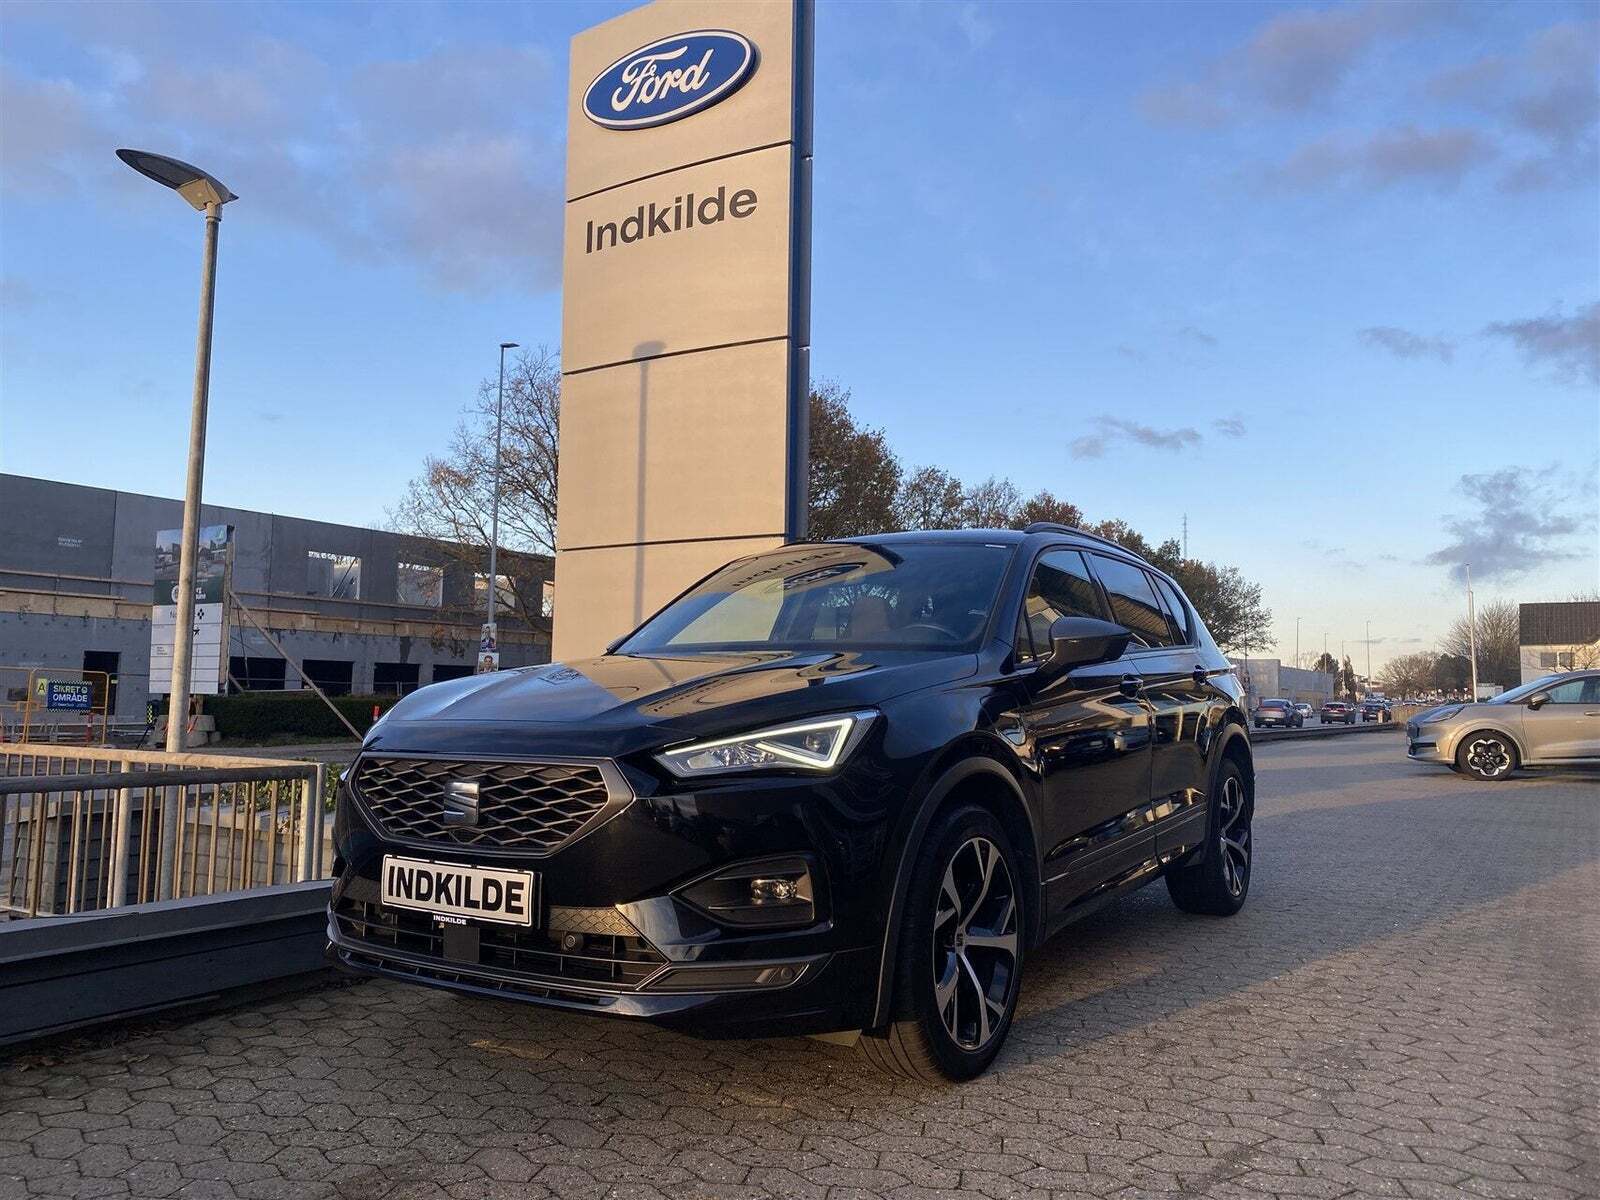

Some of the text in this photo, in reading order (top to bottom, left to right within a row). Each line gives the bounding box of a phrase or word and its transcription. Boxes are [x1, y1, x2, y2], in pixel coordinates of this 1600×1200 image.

[611, 46, 714, 112] Ford
[586, 186, 758, 254] Indkilde
[52, 692, 88, 702] OMRÅDE
[53, 685, 80, 693] SIKRET
[388, 865, 525, 915] INDKILDE
[433, 914, 467, 926] INDKILDE
